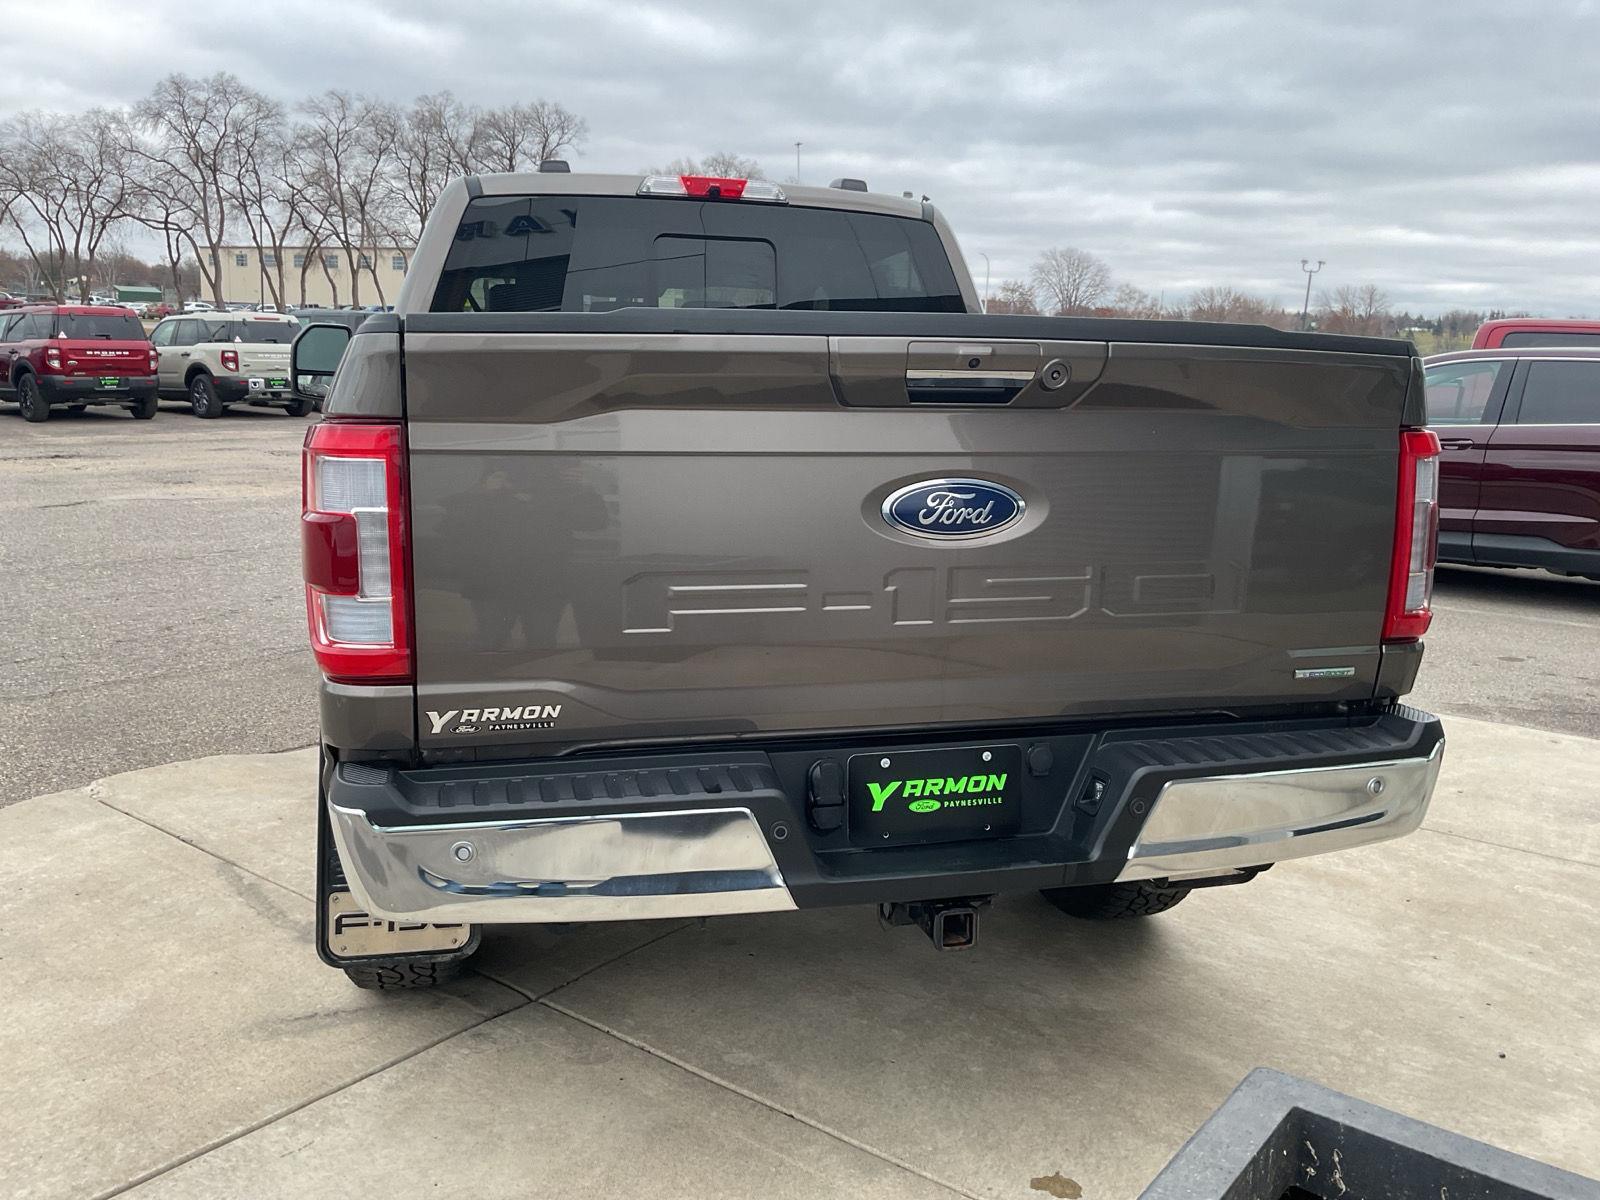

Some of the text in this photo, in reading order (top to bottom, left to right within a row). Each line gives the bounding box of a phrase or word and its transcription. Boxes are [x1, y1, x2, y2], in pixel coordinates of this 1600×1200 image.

[918, 491, 995, 525] Ford
[621, 562, 1246, 634] F-150
[425, 704, 562, 734] YARMON
[489, 722, 555, 731] PAYNESVILLE
[866, 773, 1008, 812] YARMON
[915, 797, 1003, 811] Ford PAYNESVILLE
[335, 912, 463, 935] F-1
